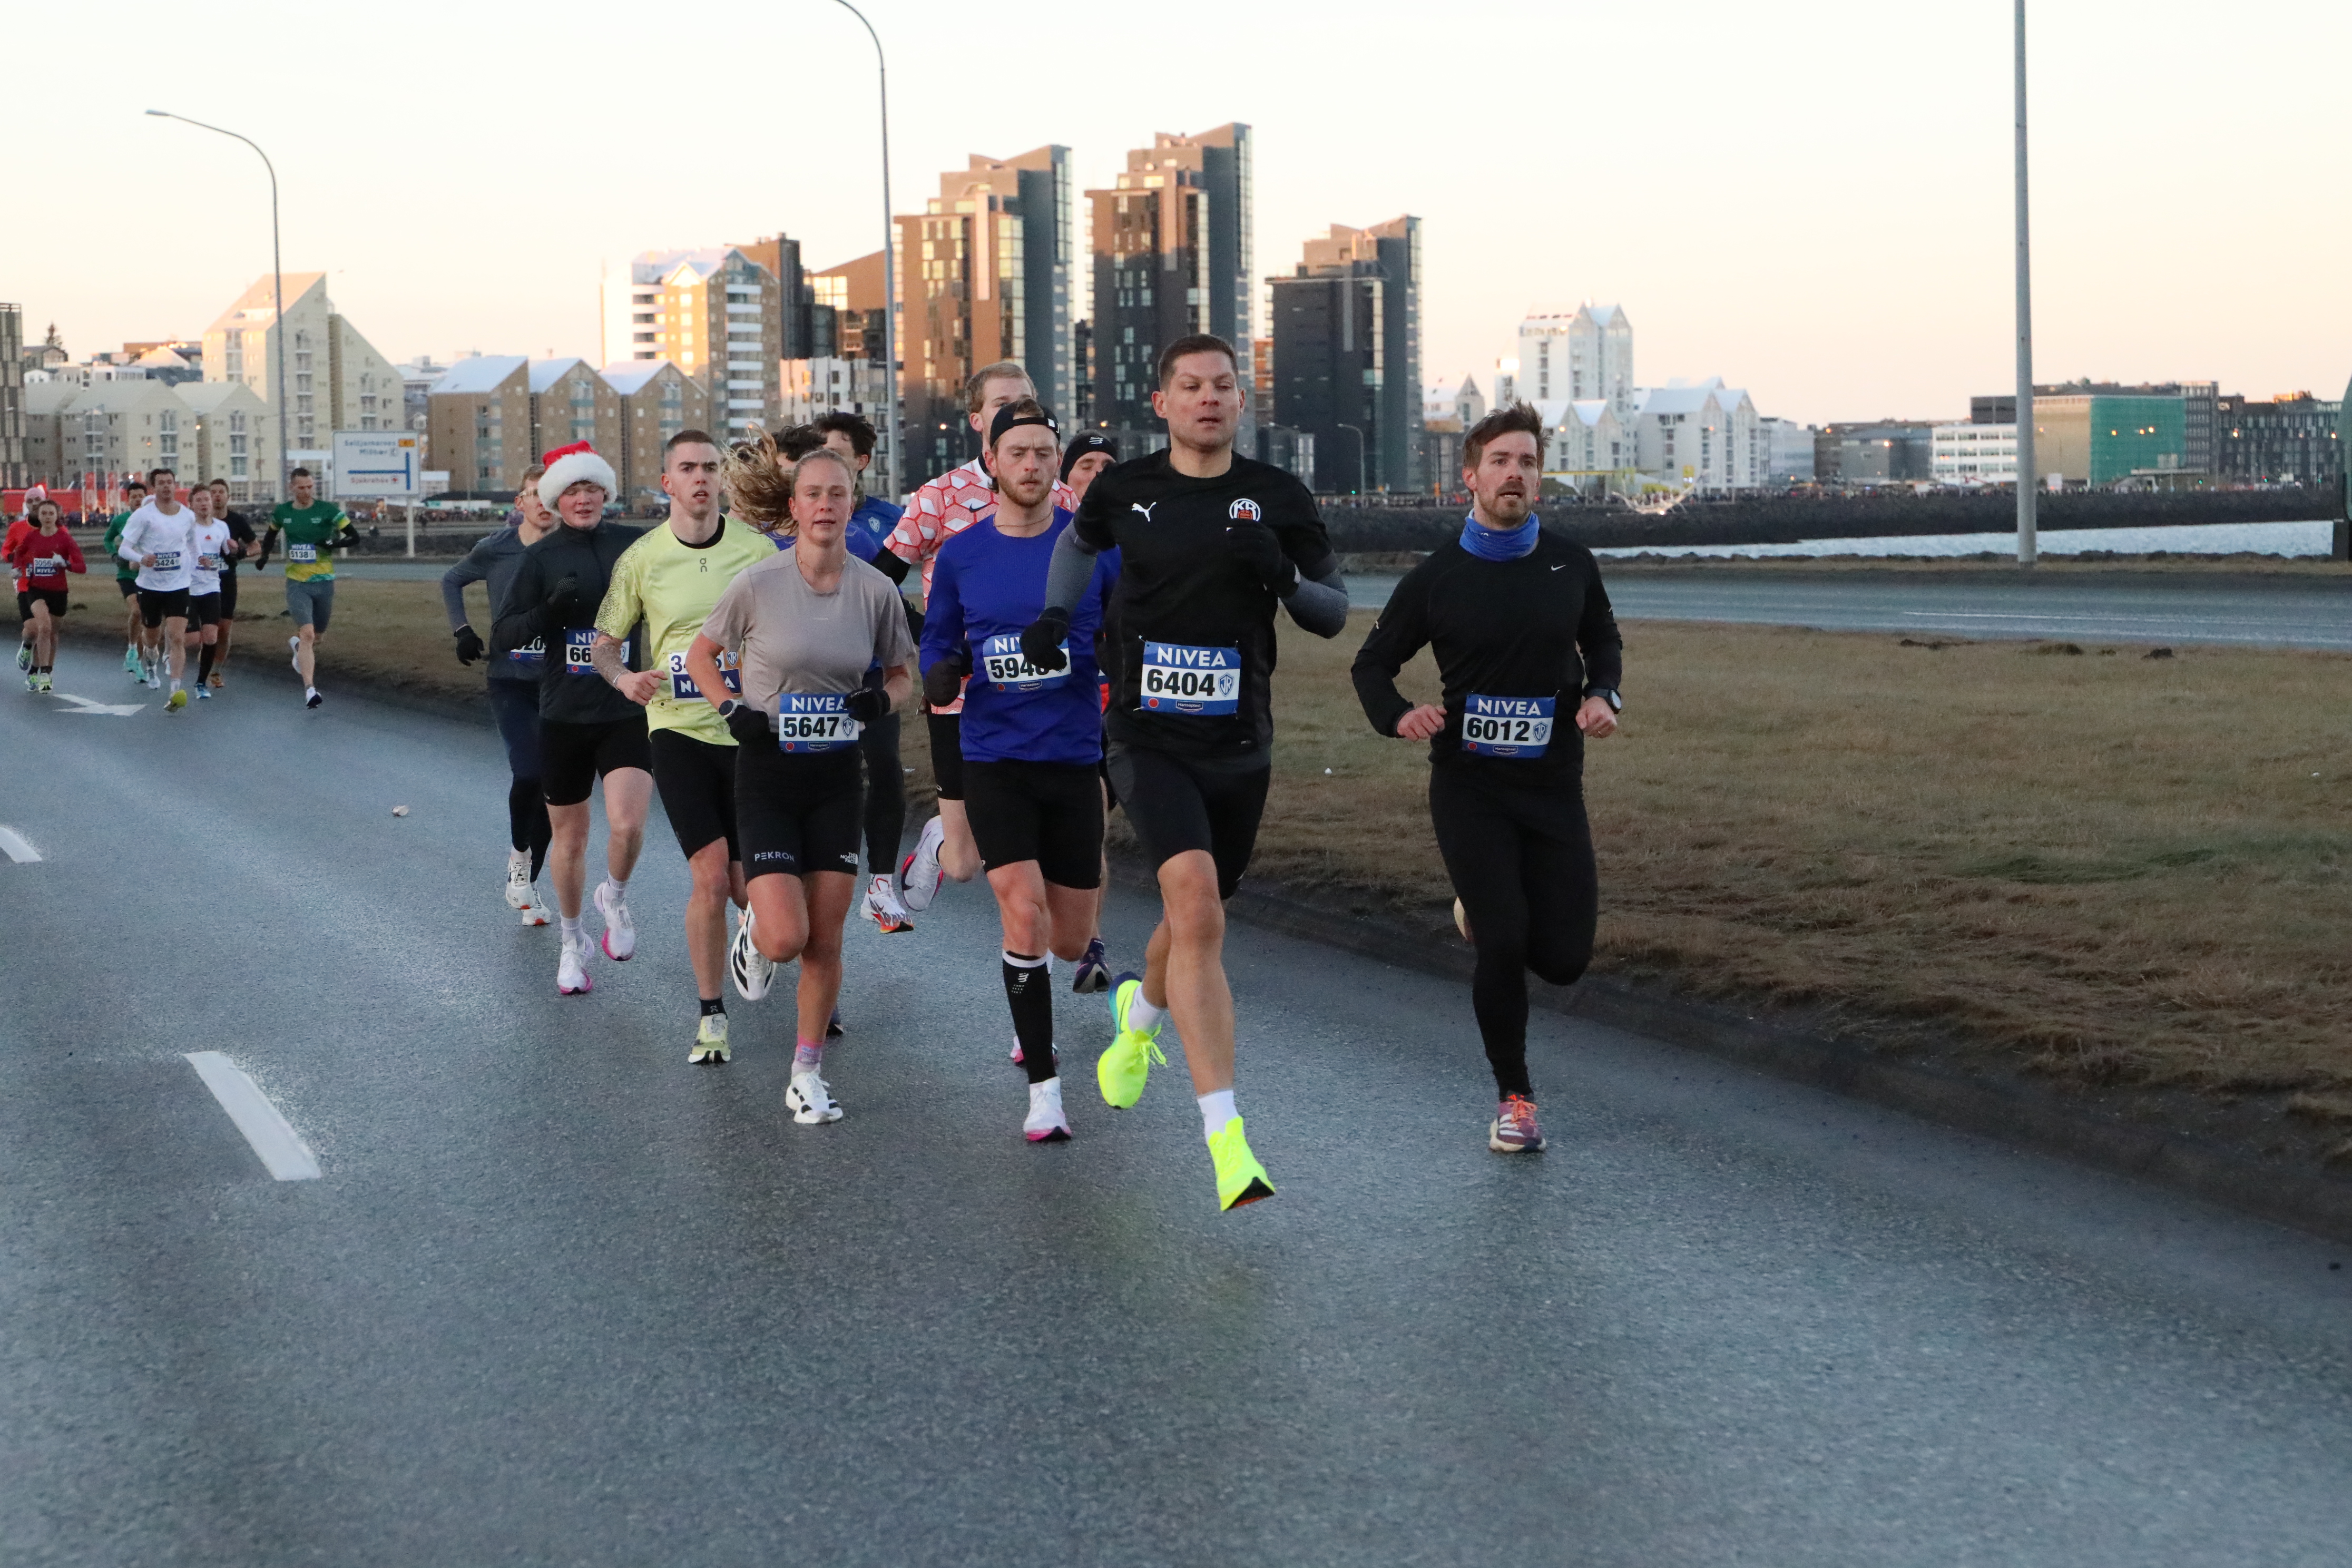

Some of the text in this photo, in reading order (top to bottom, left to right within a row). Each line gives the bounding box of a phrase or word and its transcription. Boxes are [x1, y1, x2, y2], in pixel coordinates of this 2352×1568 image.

[1233, 501, 1257, 521] KR
[570, 647, 591, 663] 66
[1158, 646, 1227, 667] NIVEA
[680, 676, 736, 693] NIA
[1147, 669, 1215, 696] 6404
[792, 697, 848, 711] NIVEA
[1477, 698, 1541, 716] NIVEA
[784, 717, 839, 738] 5647
[1467, 717, 1530, 741] 6012
[754, 851, 795, 862] PEKRON
